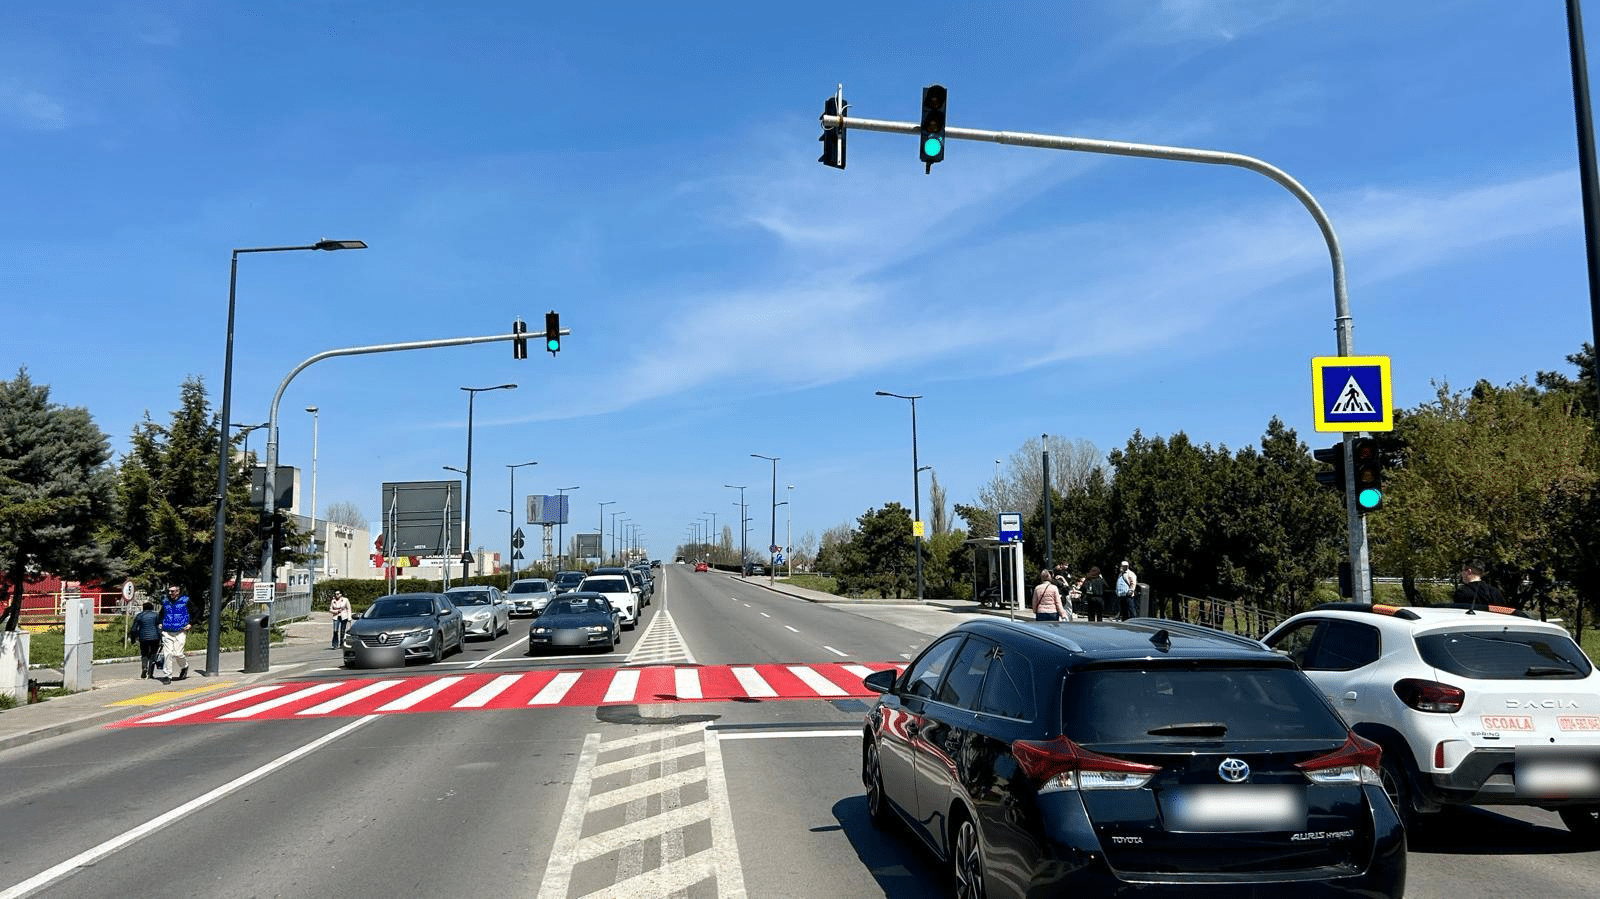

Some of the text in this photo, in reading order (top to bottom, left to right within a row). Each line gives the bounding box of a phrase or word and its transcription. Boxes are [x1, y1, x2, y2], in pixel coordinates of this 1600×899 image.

[1505, 699, 1580, 709] DACIA
[1484, 717, 1532, 730] SCOALA
[1111, 836, 1144, 844] TOYOTA
[1290, 829, 1355, 842] AURIS HYBRID
